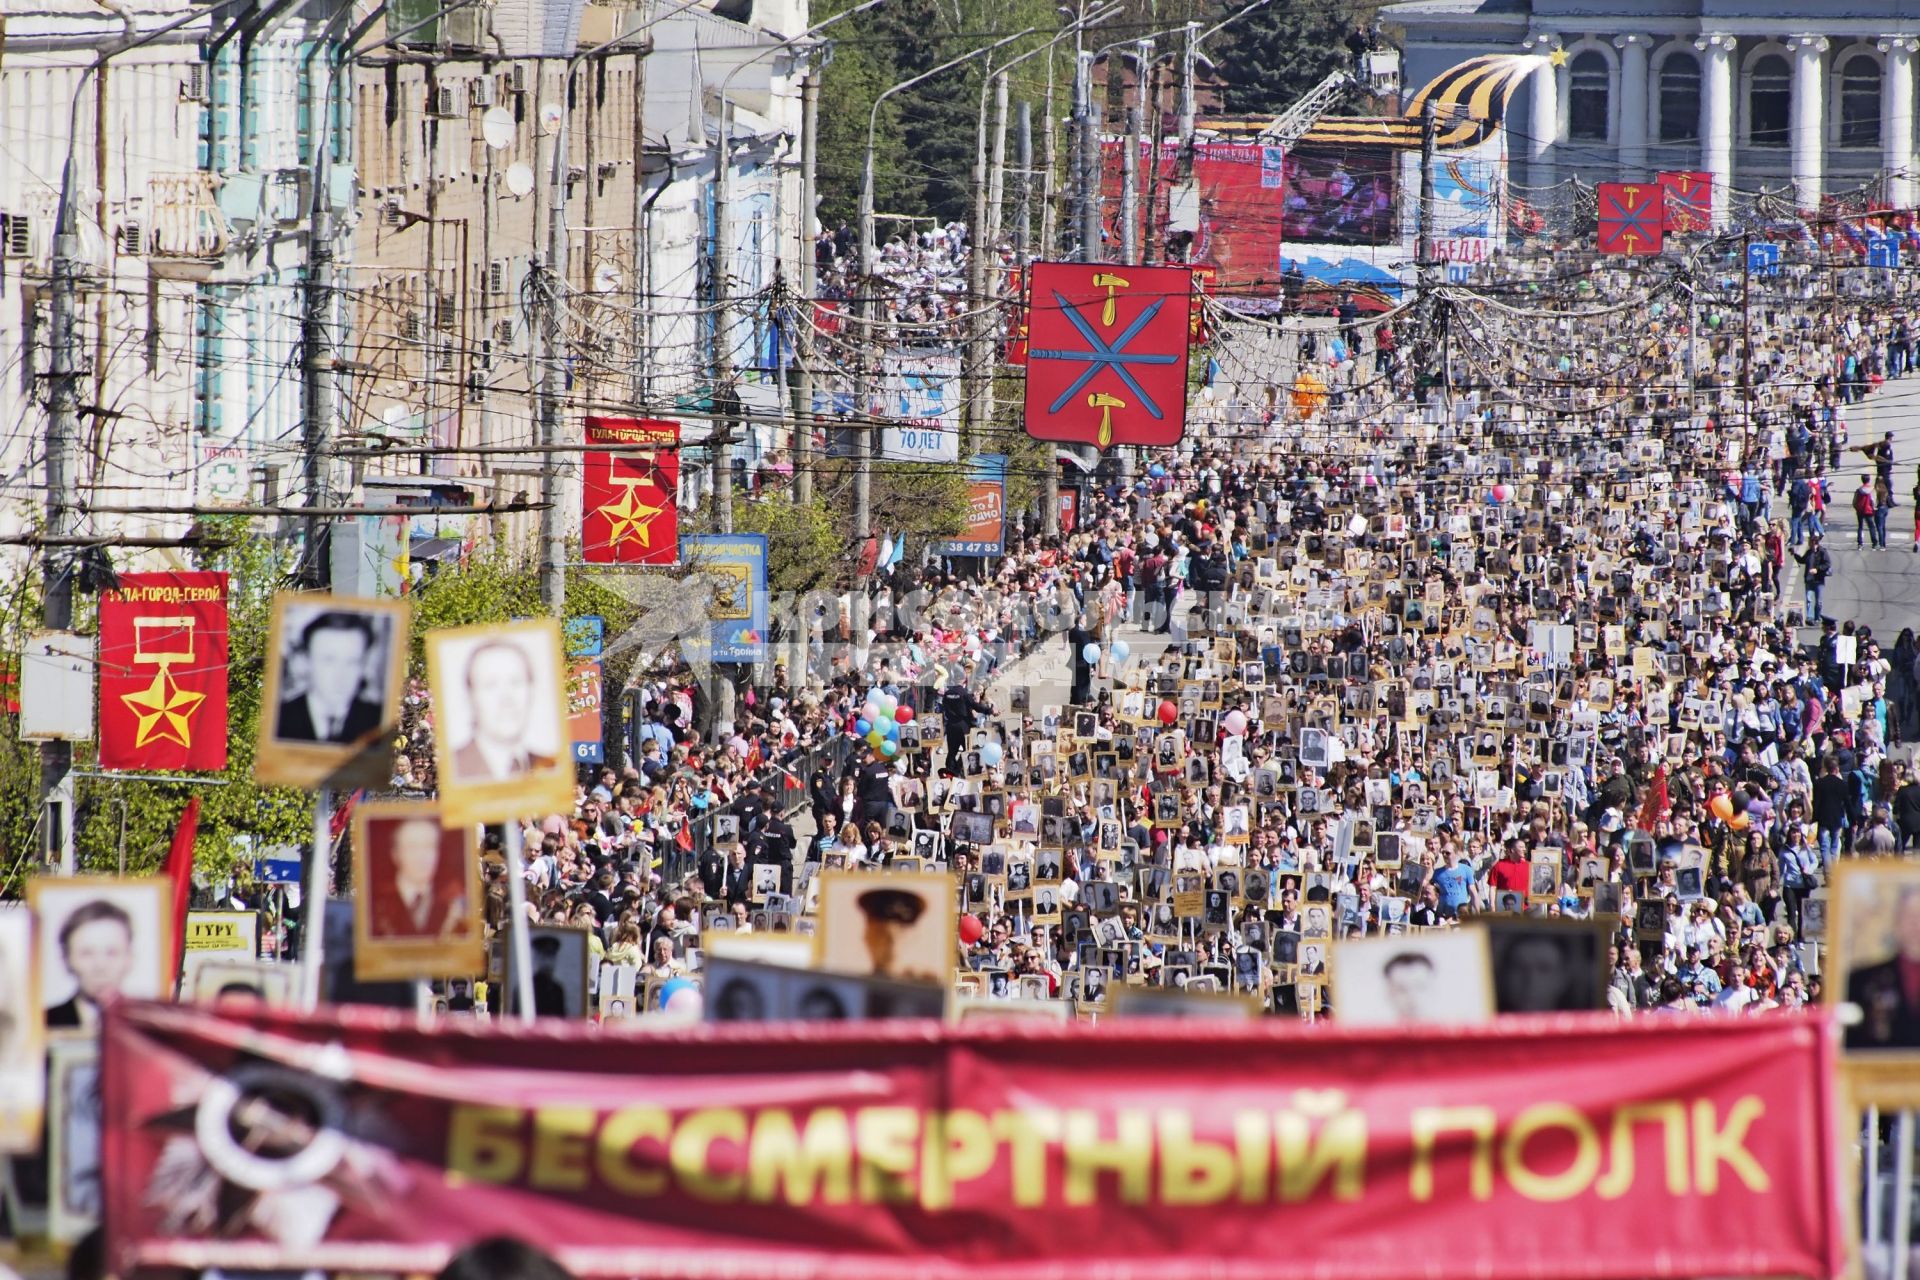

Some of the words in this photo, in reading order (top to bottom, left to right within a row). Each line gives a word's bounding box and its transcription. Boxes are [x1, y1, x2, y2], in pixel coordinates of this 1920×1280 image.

[900, 431, 916, 449] 70
[917, 432, 943, 450] ЛЕТ
[949, 542, 963, 551] 38
[966, 543, 982, 553] 47
[109, 585, 221, 604] ЛА-ГОРОД-ГЕРОЙ
[577, 743, 597, 757] 61
[446, 1090, 1368, 1210] БЕССМЕРТНЫЙ
[1409, 1094, 1771, 1201] ПОЛК
